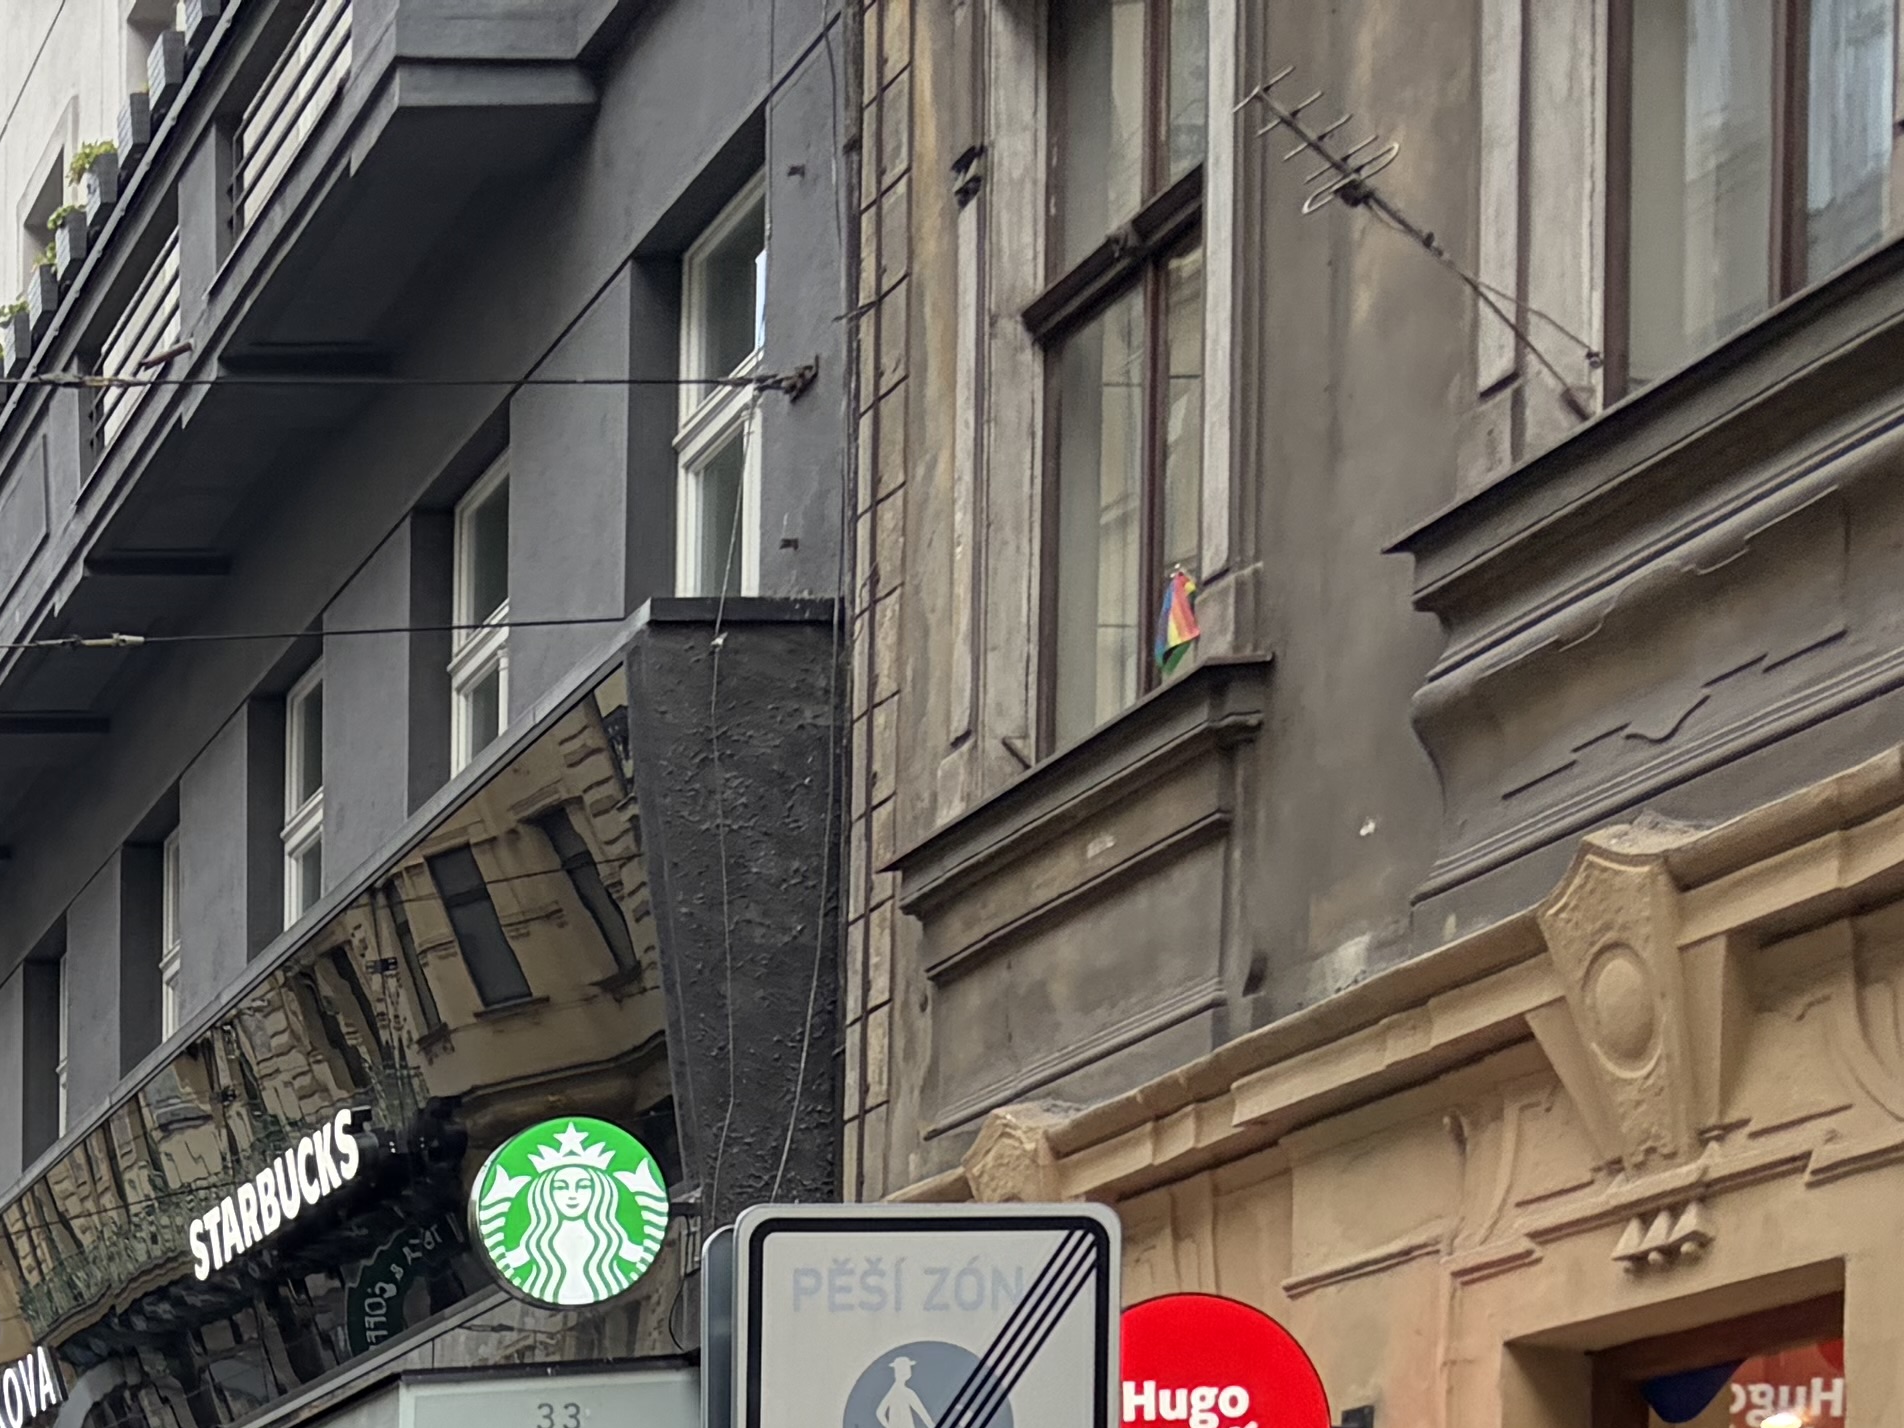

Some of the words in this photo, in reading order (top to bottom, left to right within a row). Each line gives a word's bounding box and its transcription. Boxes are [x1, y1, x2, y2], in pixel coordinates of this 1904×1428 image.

[190, 1109, 359, 1281] STARBUCKS
[792, 1256, 906, 1313] PĚŠÍ
[922, 1255, 1026, 1313] ZÓN
